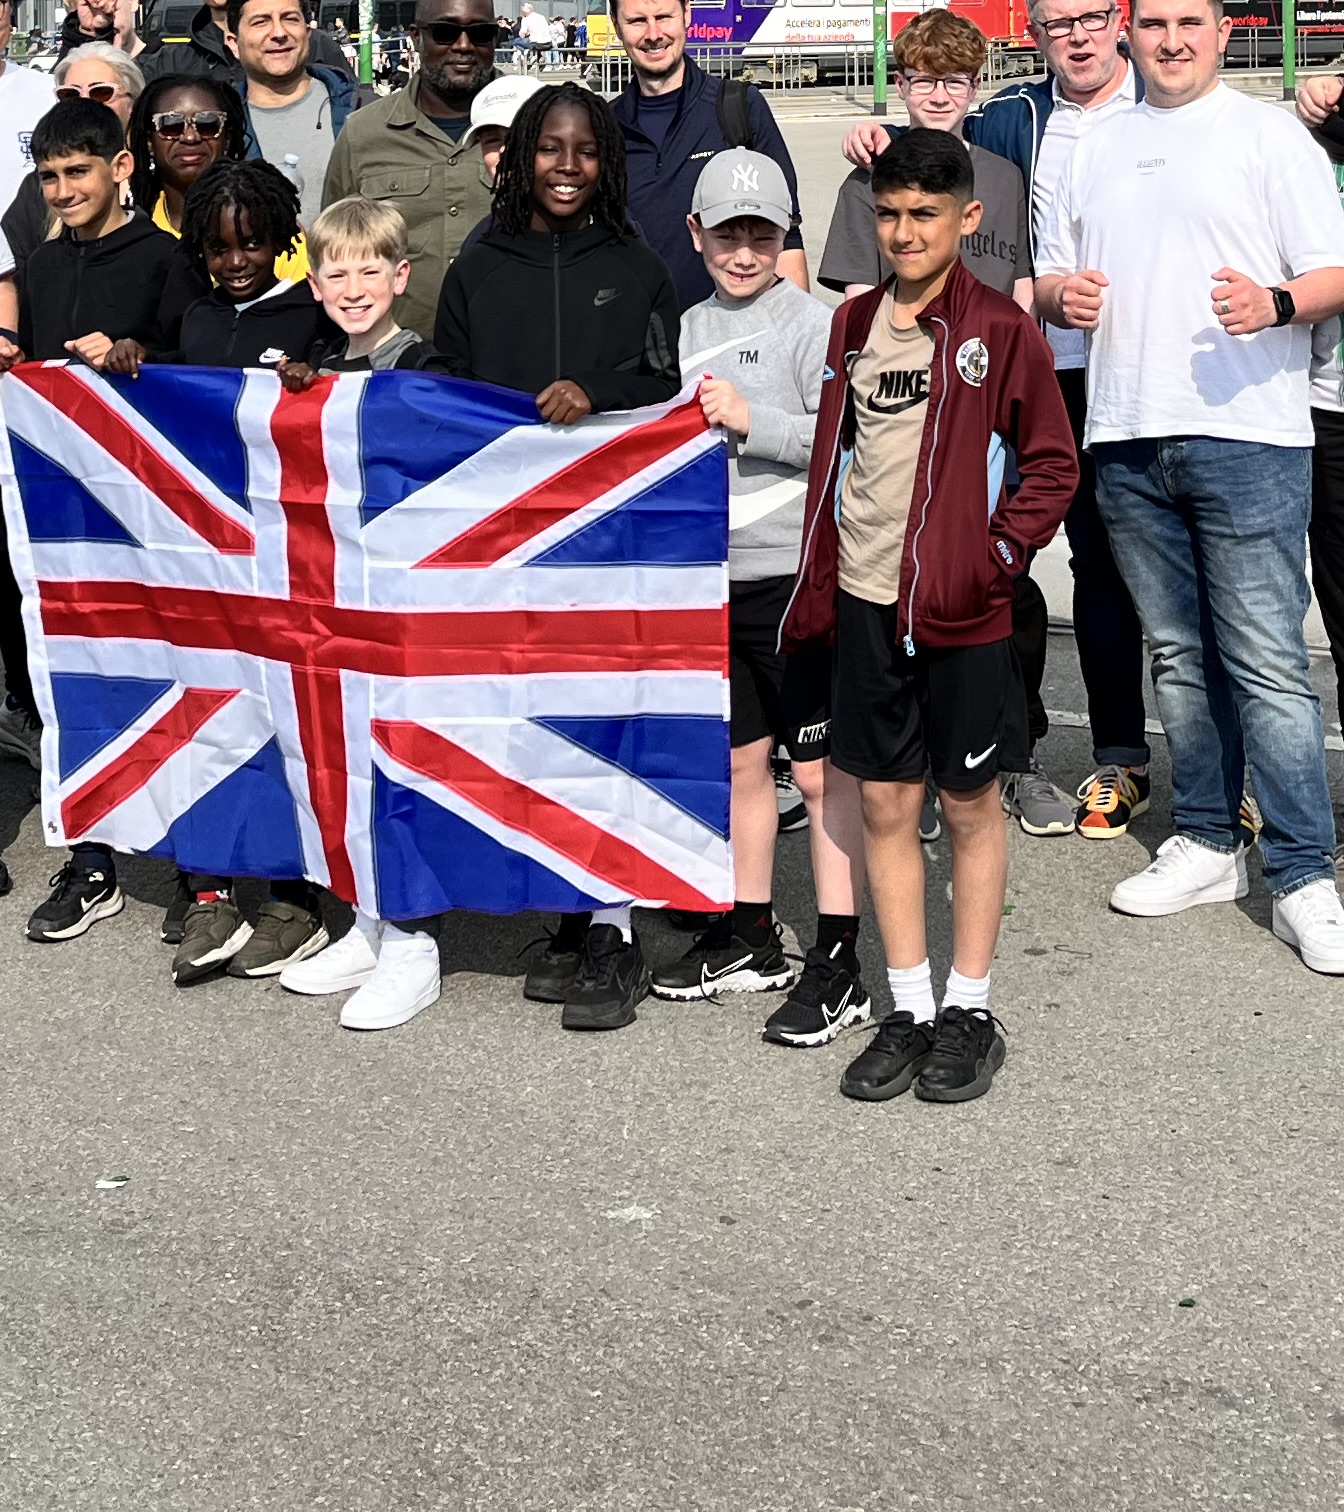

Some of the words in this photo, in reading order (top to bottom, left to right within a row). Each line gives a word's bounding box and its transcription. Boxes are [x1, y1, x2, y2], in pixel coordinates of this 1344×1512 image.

[685, 22, 733, 42] rldpay
[785, 18, 821, 29] Accelera
[826, 17, 871, 29] pagamenti
[959, 231, 1017, 265] ngeles
[738, 349, 759, 364] TM
[875, 369, 930, 399] NIKE
